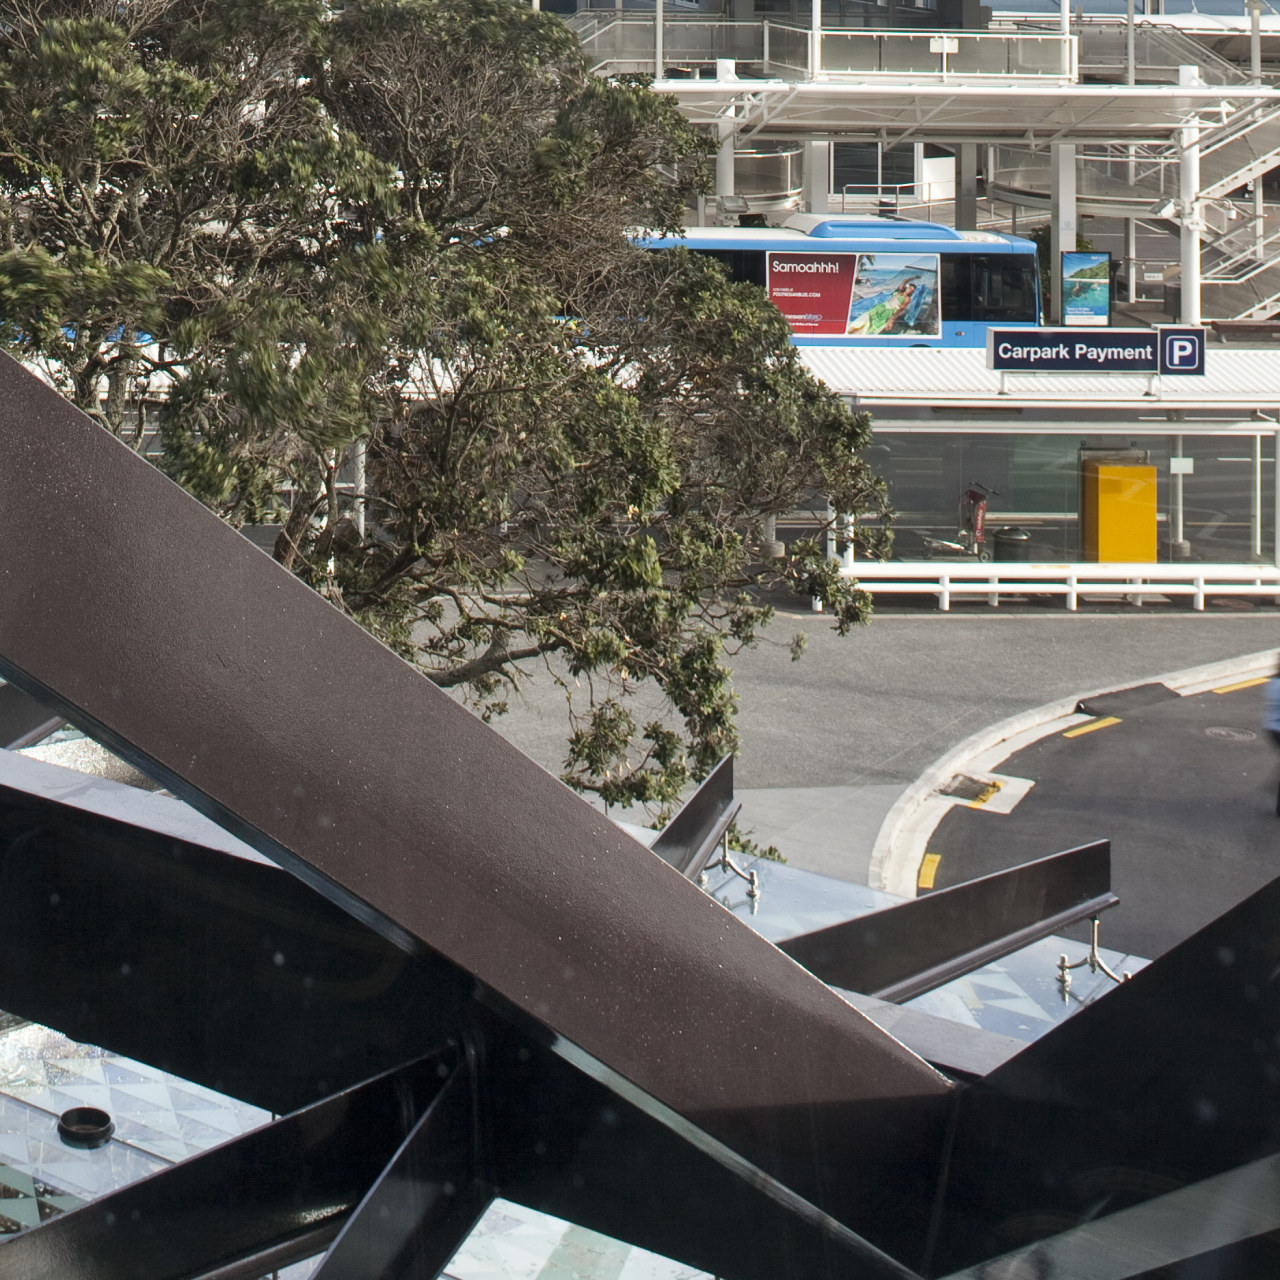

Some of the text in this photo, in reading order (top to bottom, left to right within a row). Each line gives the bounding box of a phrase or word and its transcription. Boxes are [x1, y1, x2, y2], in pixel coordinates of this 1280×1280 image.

[772, 261, 839, 273] Samoahhh!
[998, 342, 1153, 363] Carpark Payment
[1172, 340, 1193, 365] P
